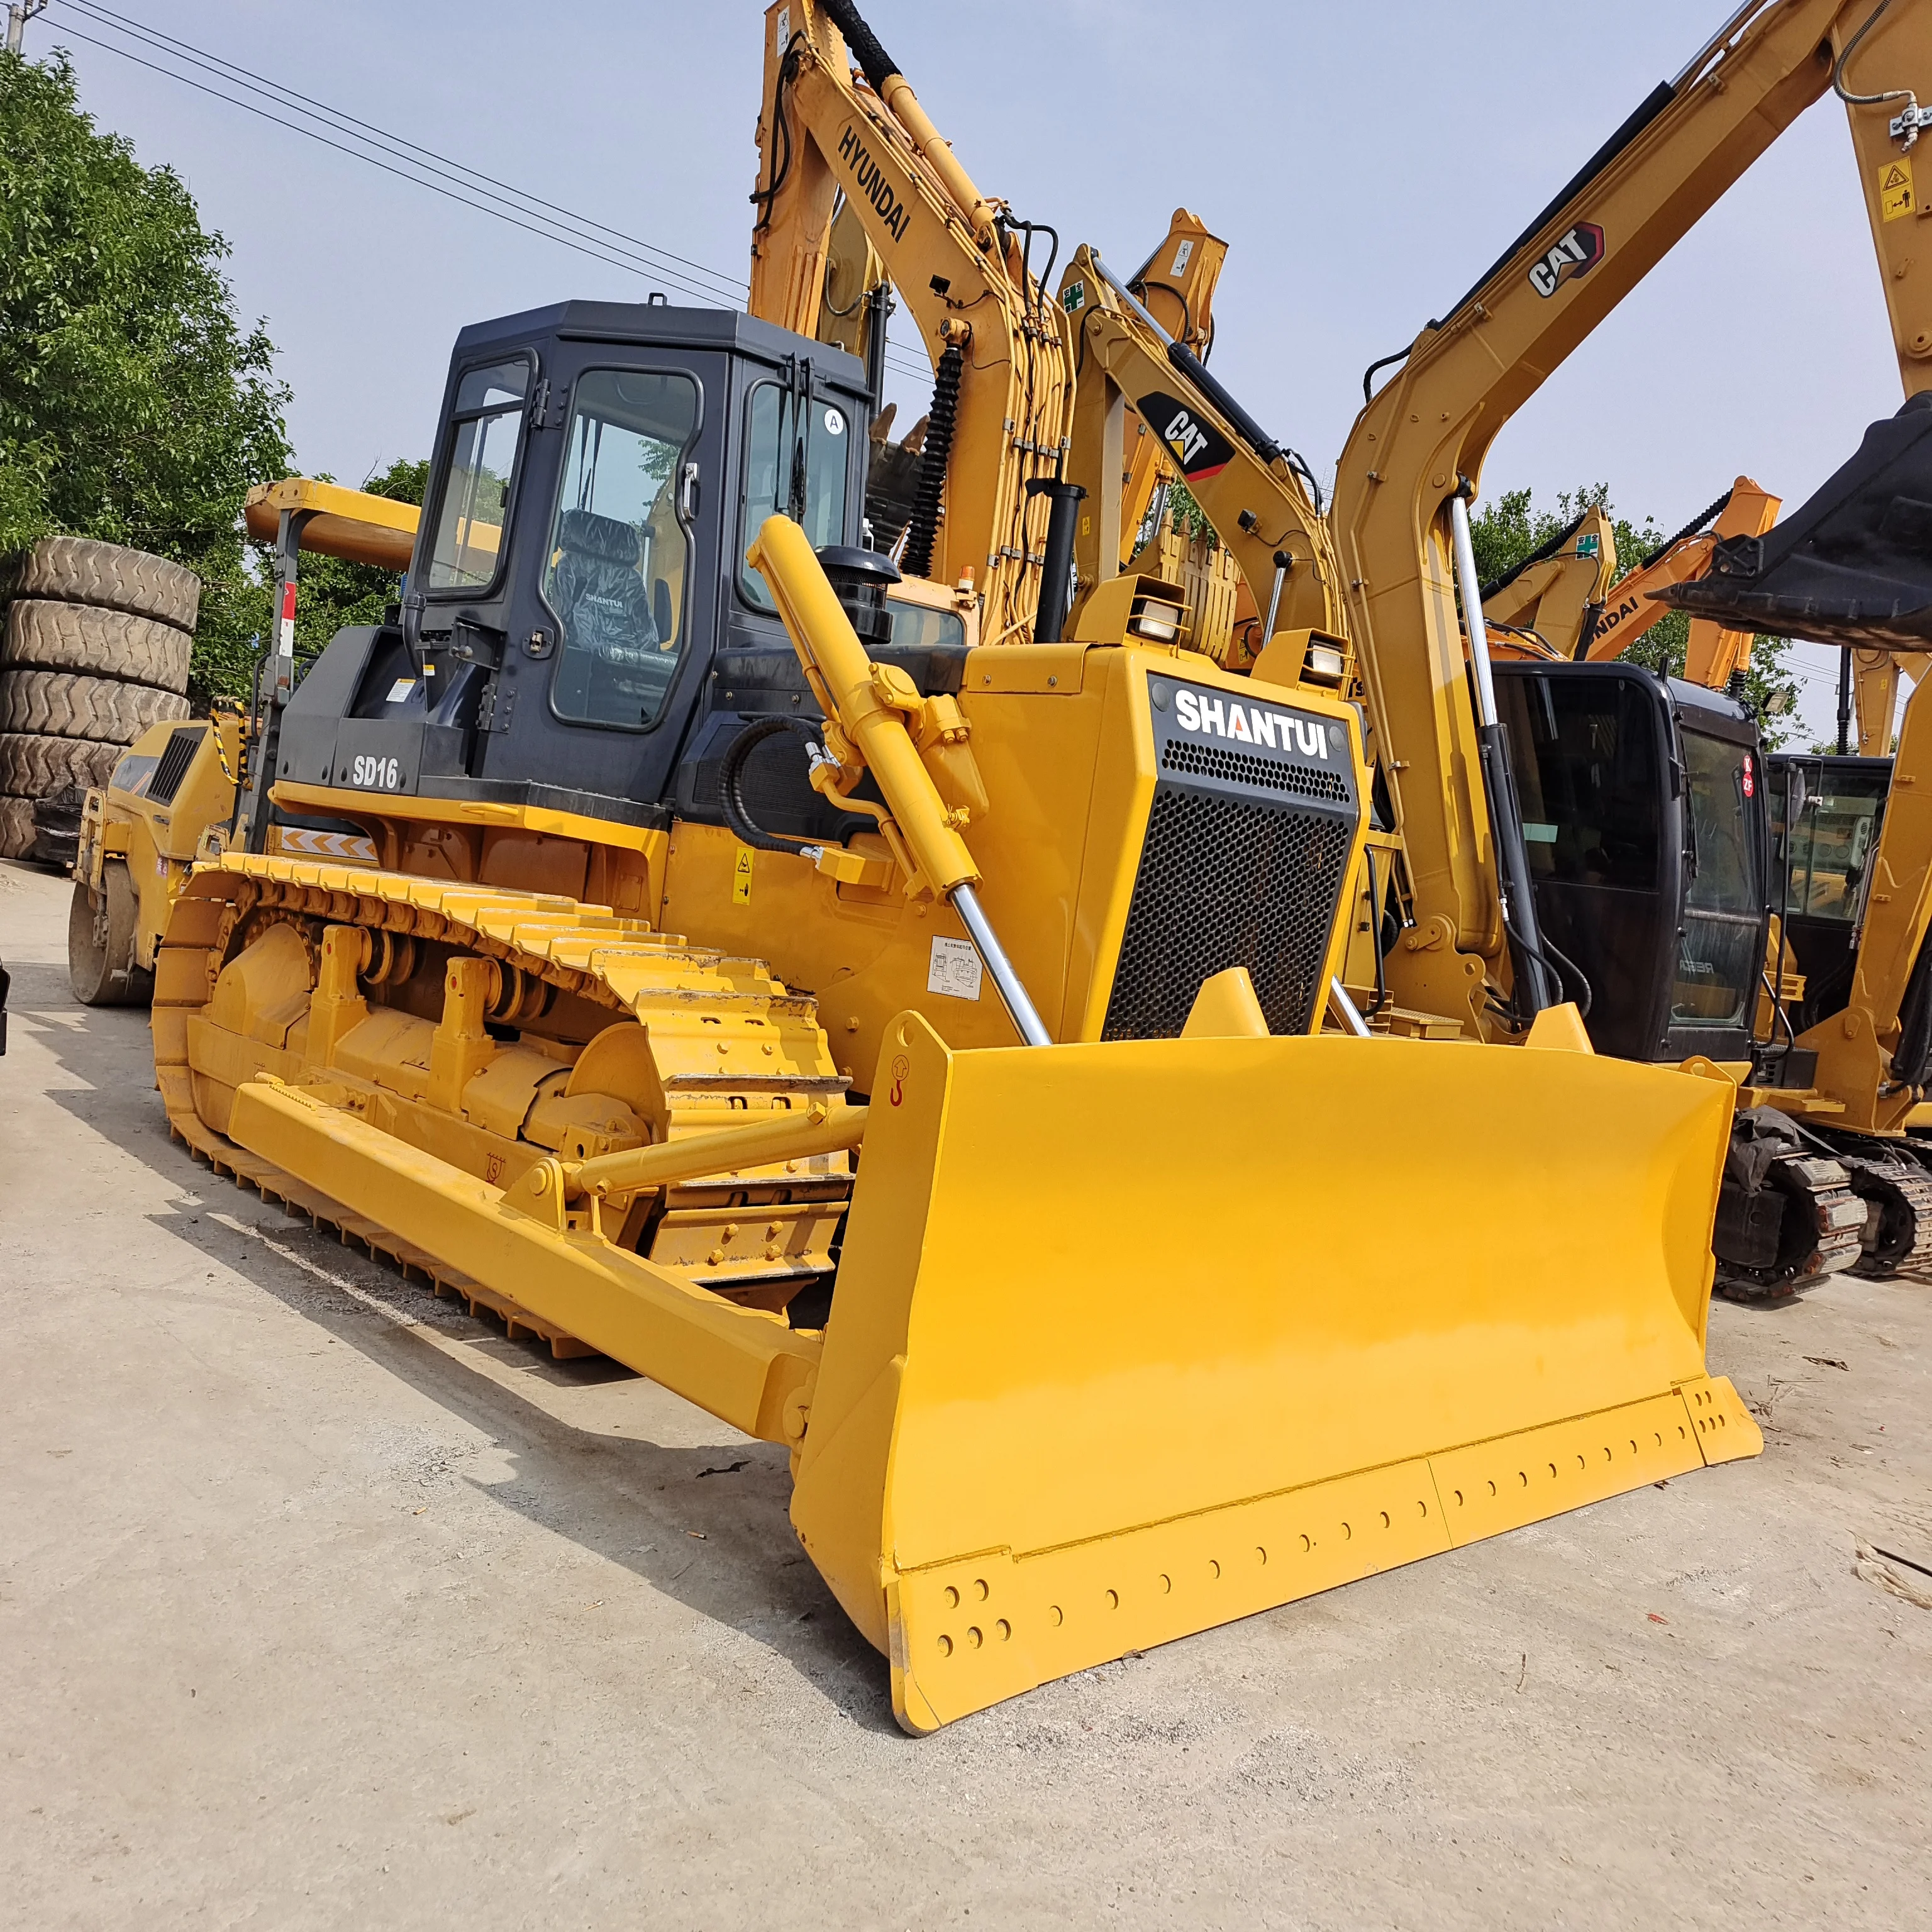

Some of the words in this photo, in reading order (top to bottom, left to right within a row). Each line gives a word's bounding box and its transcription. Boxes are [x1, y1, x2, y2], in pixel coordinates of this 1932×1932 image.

[838, 125, 911, 244] HYUNDAI
[1529, 228, 1588, 296] CAT
[830, 414, 839, 429] A
[1164, 410, 1208, 465] CAT
[585, 592, 624, 608] SHANTUI
[1589, 596, 1640, 646] NDAI
[1175, 689, 1329, 760] SHANTUI
[353, 755, 398, 789] SD16
[1743, 778, 1753, 792] ZF
[1744, 757, 1752, 773] K
